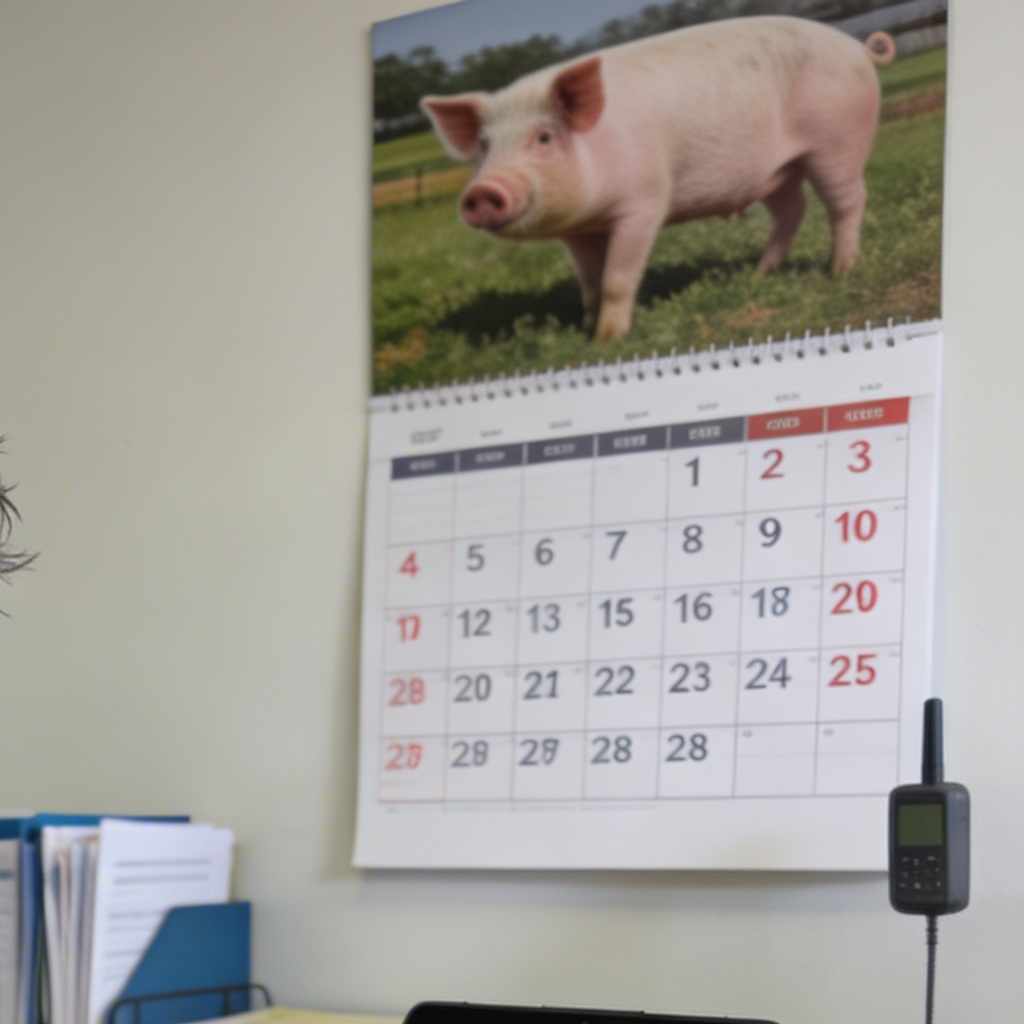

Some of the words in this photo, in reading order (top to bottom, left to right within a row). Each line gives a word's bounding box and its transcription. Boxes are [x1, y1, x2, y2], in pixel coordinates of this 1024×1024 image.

[686, 457, 699, 487] 1
[760, 449, 784, 479] 2
[848, 440, 872, 473] 3
[399, 552, 419, 577] 4
[467, 544, 485, 572] 5
[534, 538, 554, 566] 6
[606, 530, 627, 560] 7
[682, 524, 703, 553] 8
[759, 517, 781, 547] 9
[836, 509, 877, 542] 10
[458, 608, 491, 638] 12
[527, 603, 560, 633] 13
[599, 598, 634, 628] 15
[674, 592, 712, 623] 16
[752, 586, 790, 618] 18
[831, 580, 878, 615] 20
[454, 673, 492, 703] 20
[523, 670, 558, 700] 21
[595, 665, 635, 696] 22
[669, 661, 710, 693] 23
[745, 657, 791, 690] 24
[828, 654, 877, 687] 25
[591, 735, 632, 764] 28
[666, 733, 708, 762] 28
